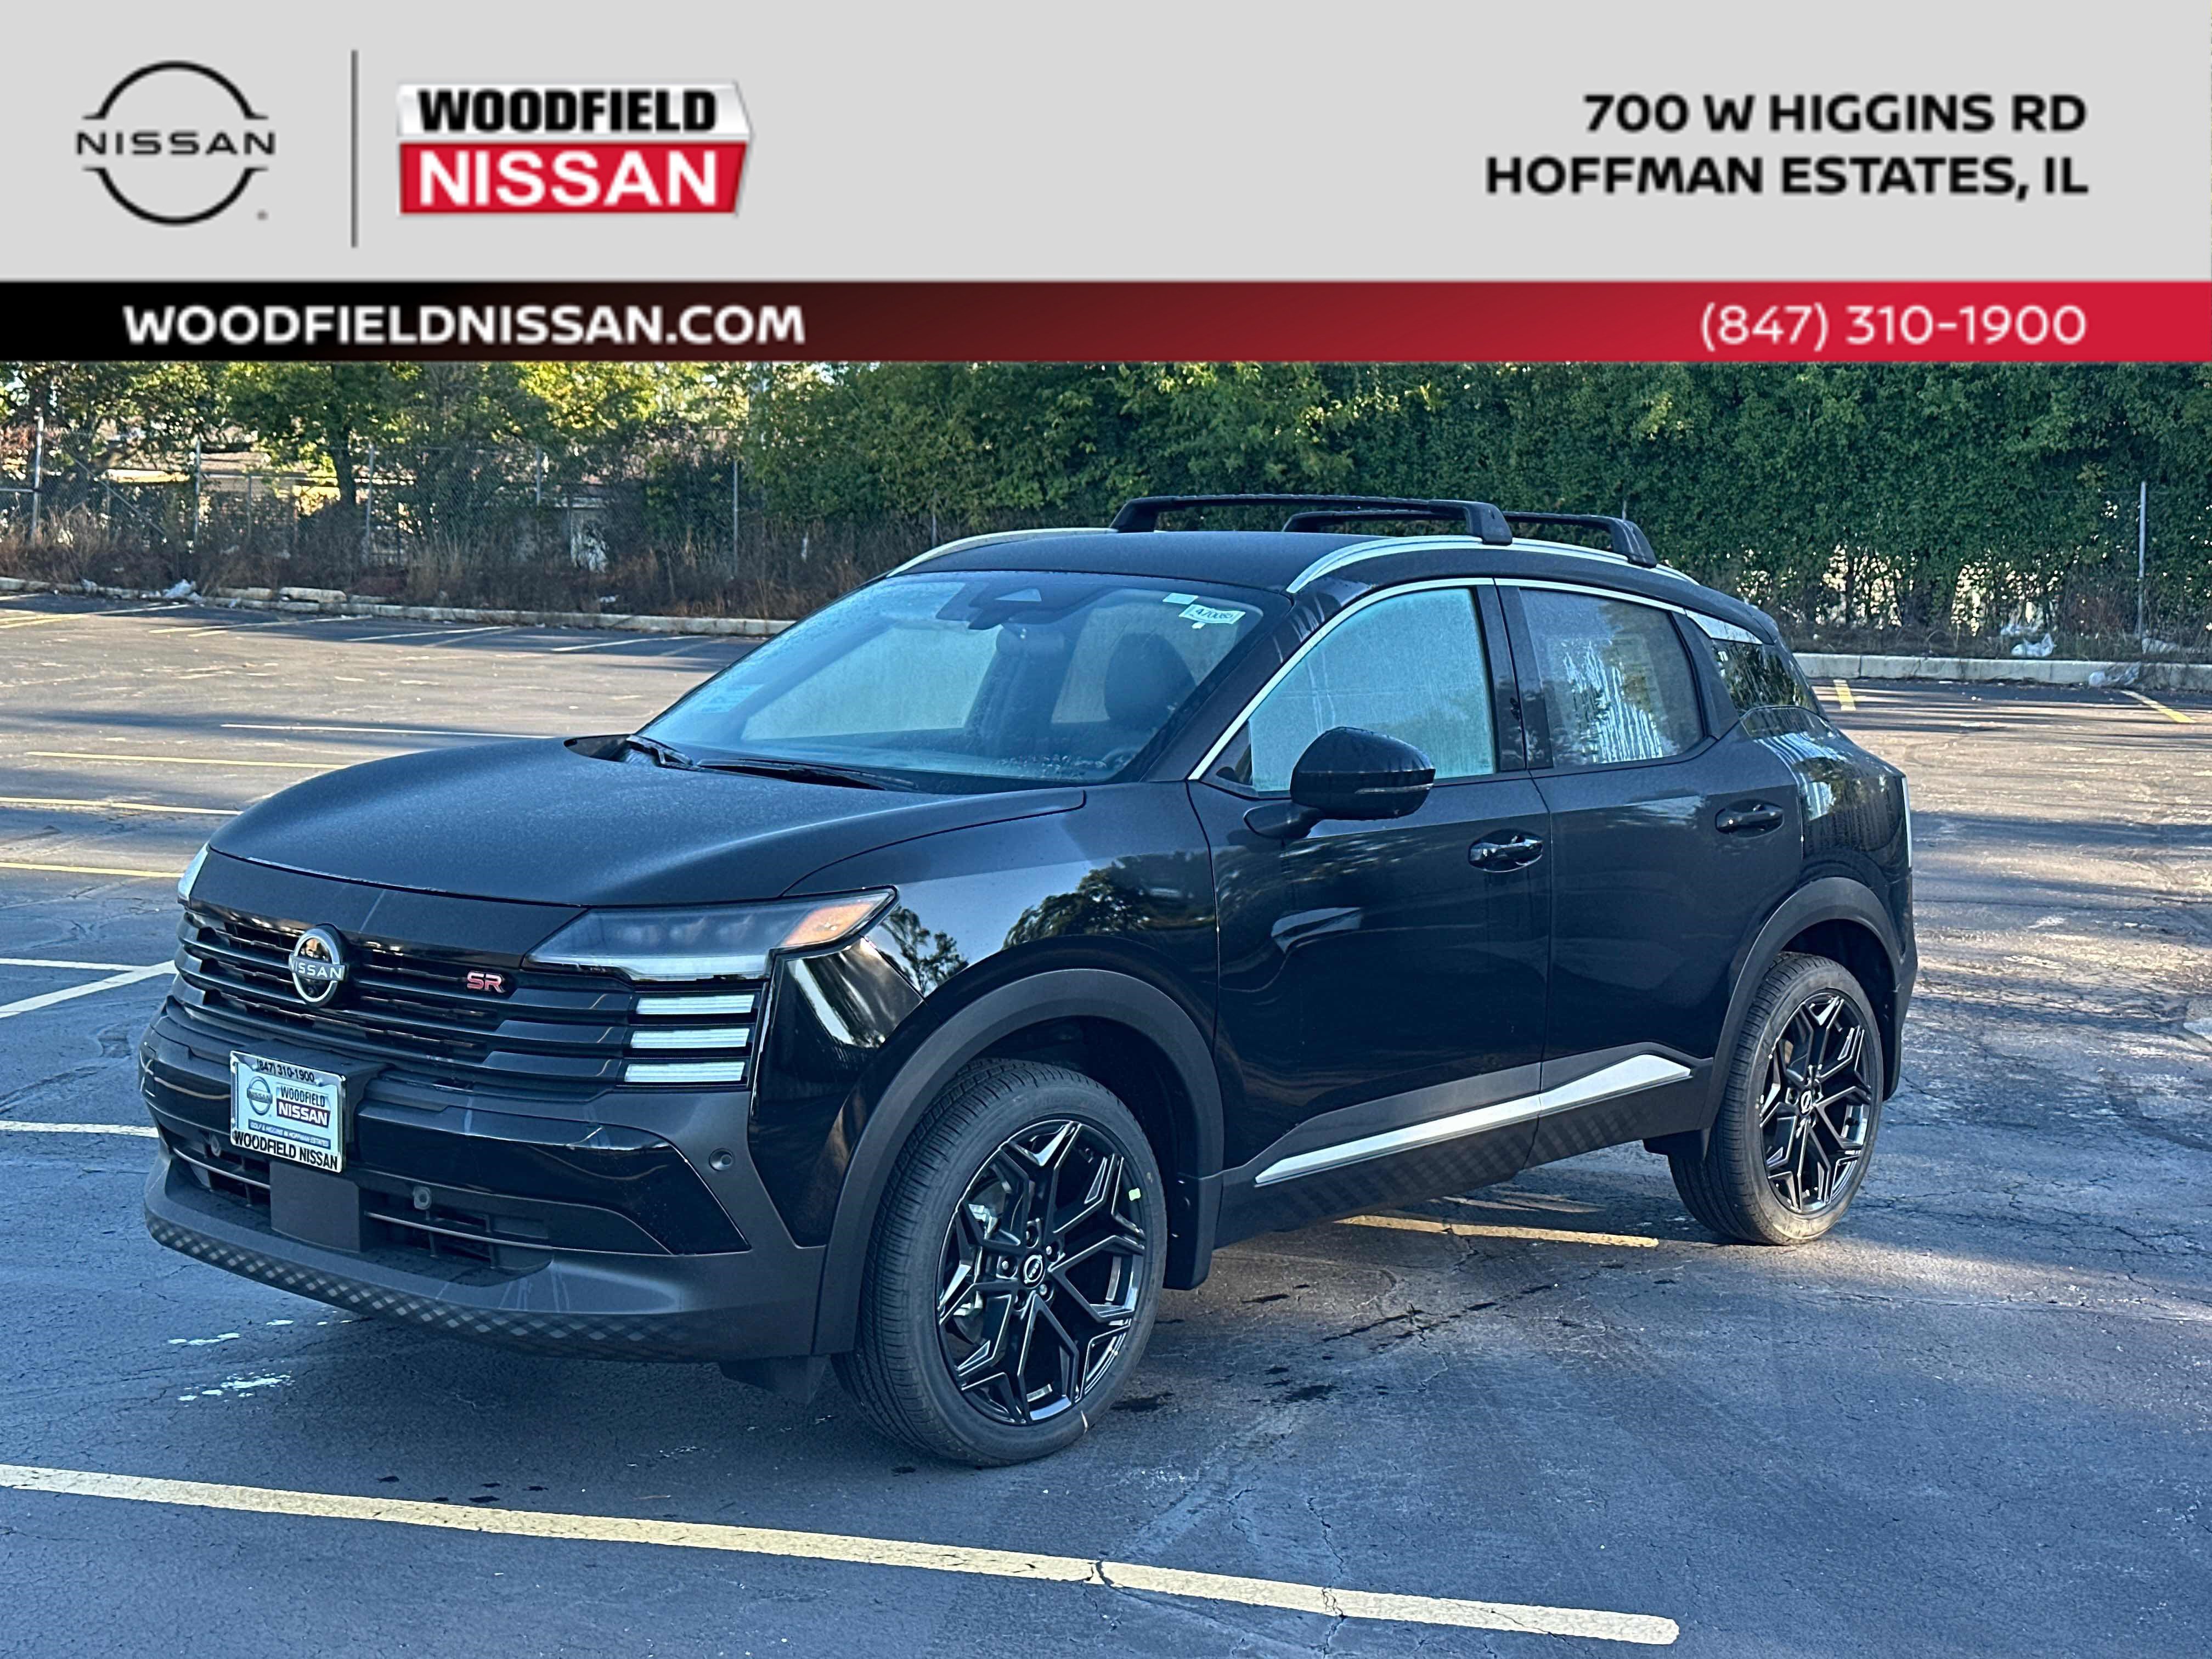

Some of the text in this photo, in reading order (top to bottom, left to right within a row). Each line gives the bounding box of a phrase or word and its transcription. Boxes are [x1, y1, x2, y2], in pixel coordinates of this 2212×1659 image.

[289, 959, 342, 980] NISSAN
[466, 971, 506, 993] SR
[276, 1063, 315, 1082] 310-1900
[280, 1086, 325, 1107] WOODFIELD
[278, 1101, 329, 1125] NISSAN
[234, 1130, 337, 1170] WOODFIELD NISSAN
